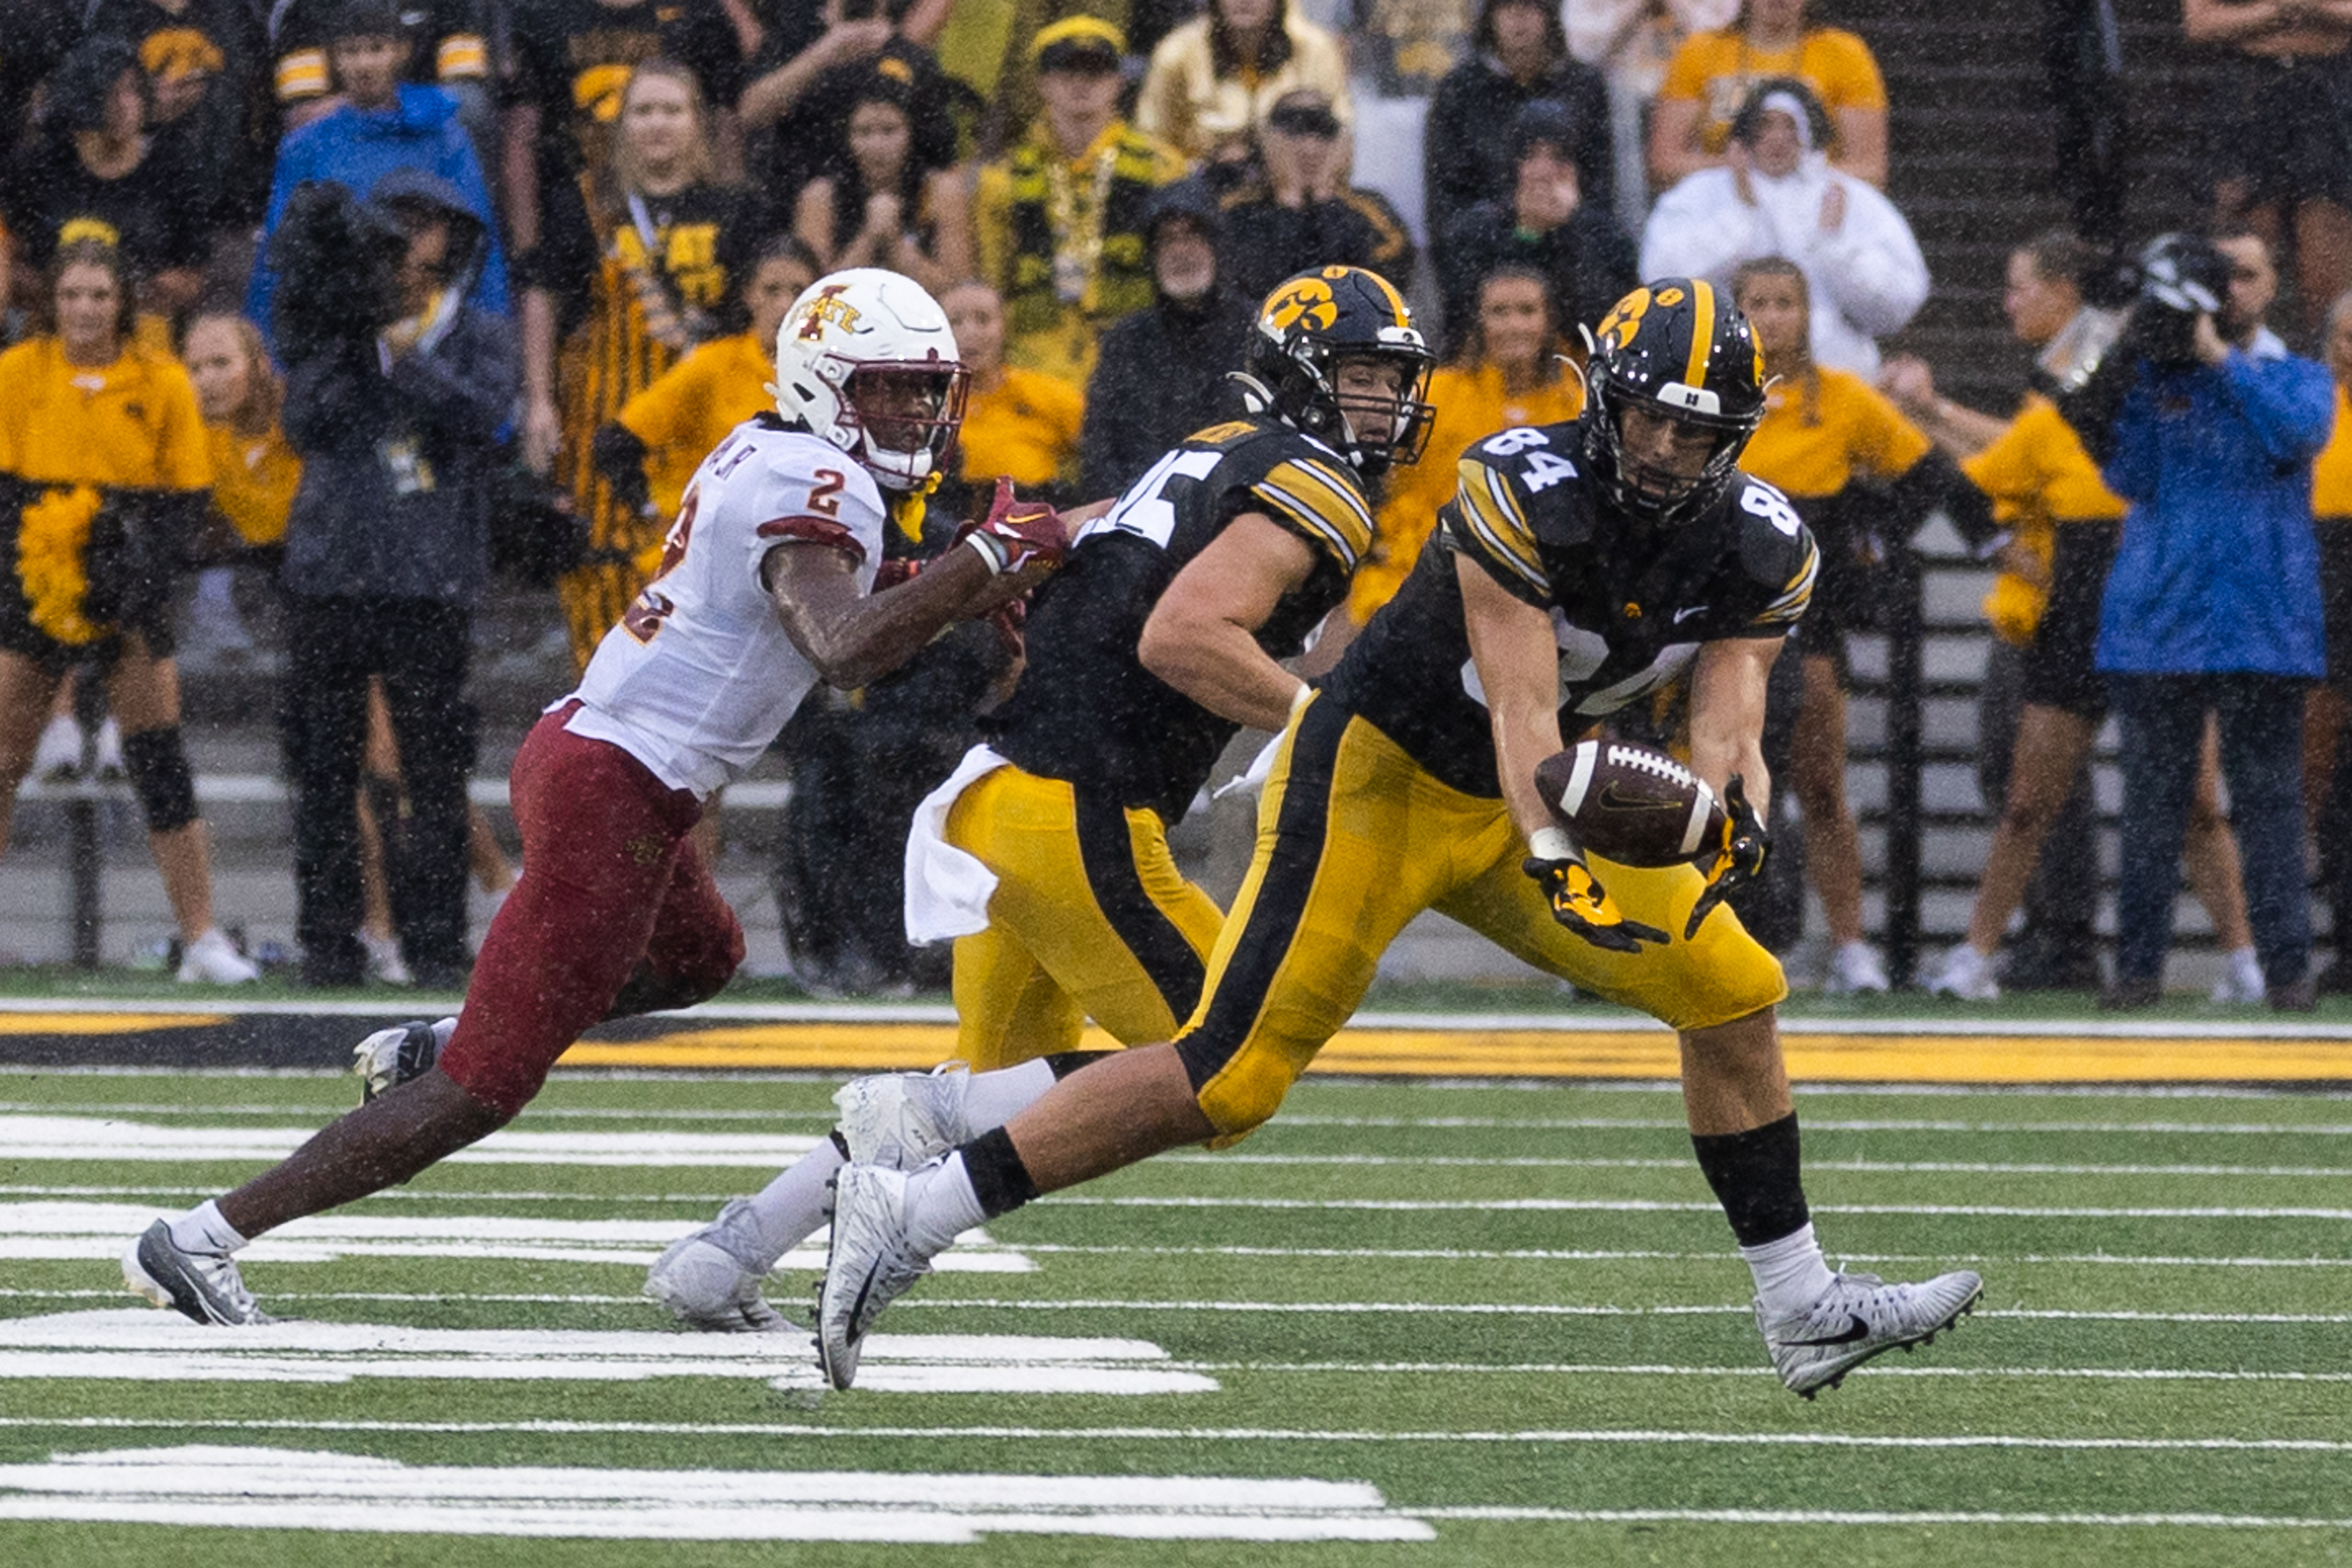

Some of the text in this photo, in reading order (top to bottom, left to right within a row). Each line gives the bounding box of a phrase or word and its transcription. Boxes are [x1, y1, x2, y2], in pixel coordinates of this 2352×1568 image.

[1482, 427, 1579, 494] 84
[807, 469, 845, 517] 2
[1740, 473, 1801, 537] 8
